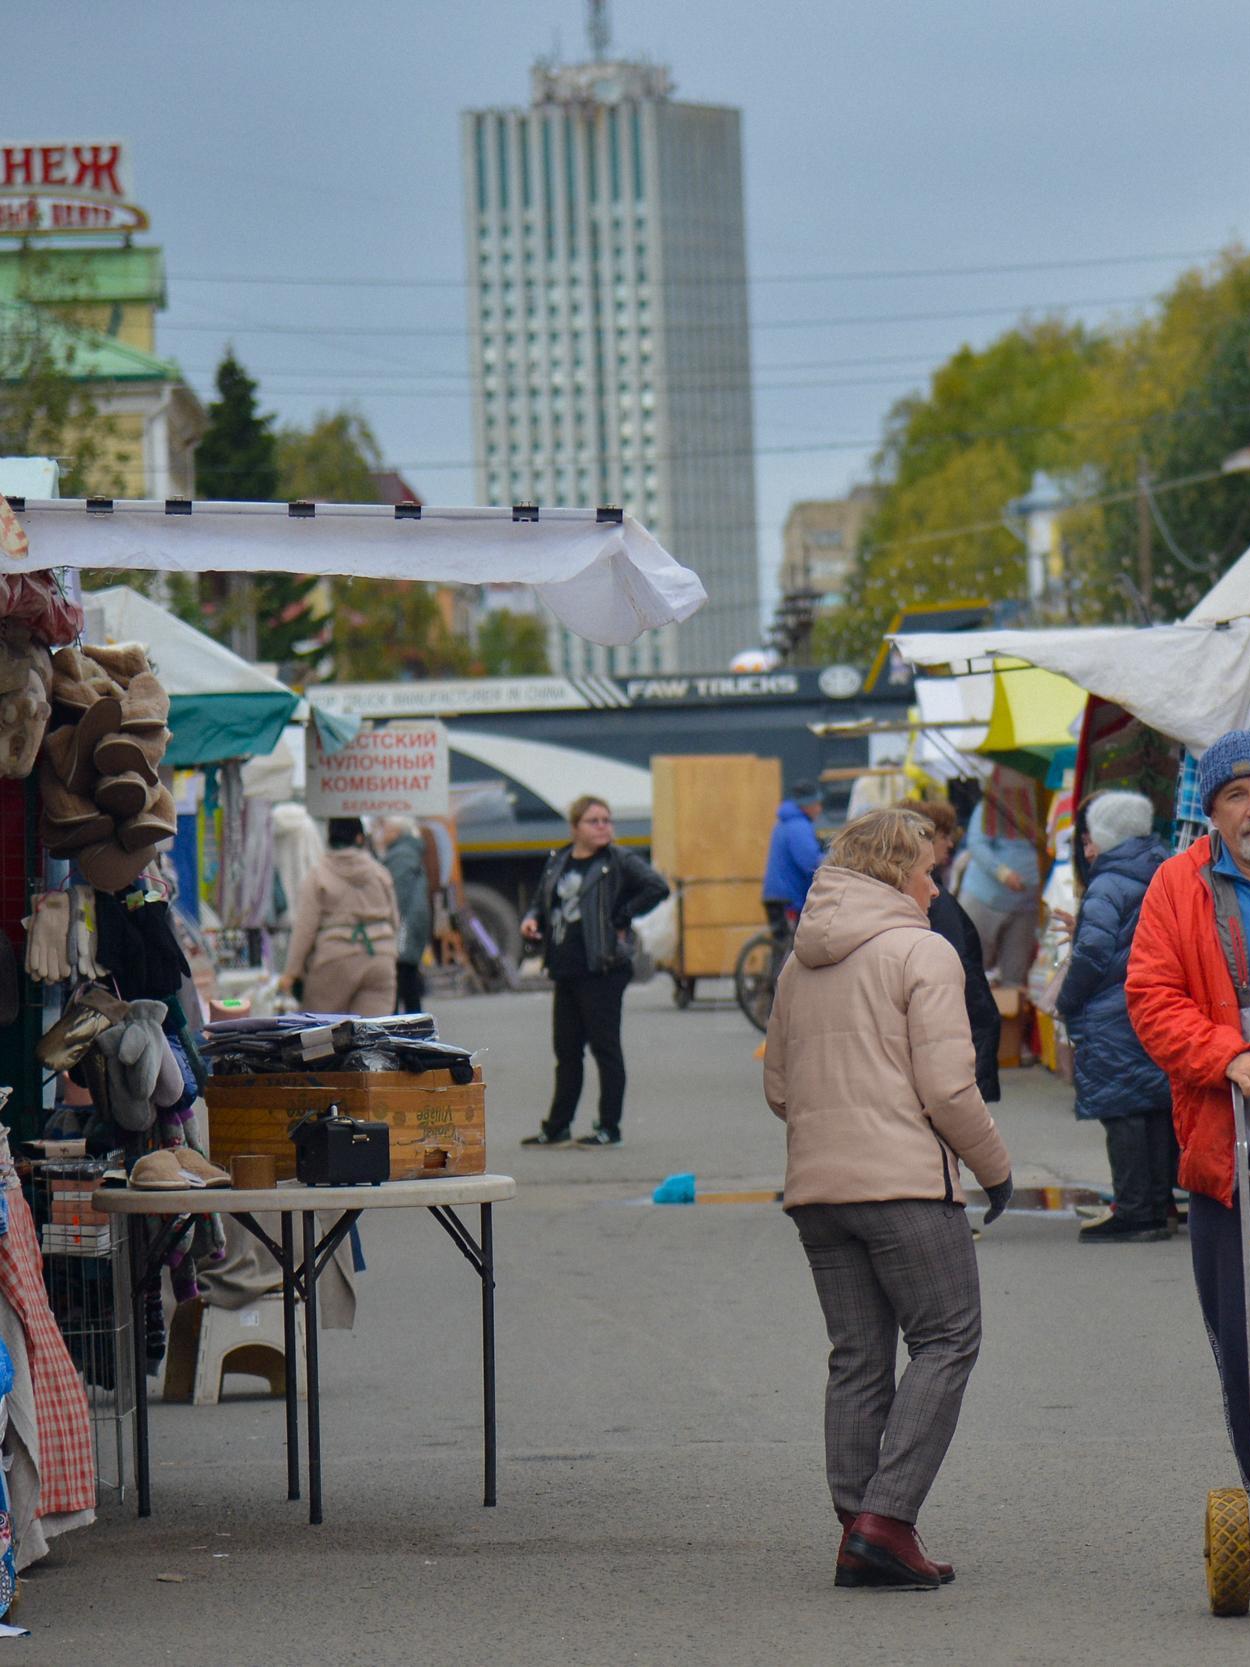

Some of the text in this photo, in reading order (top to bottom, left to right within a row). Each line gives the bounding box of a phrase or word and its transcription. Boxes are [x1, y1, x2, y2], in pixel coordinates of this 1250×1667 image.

[627, 675, 798, 700] FAW TRUCKS
[317, 731, 438, 752] СТСКИЙ
[319, 752, 436, 770] ЧУЛОЧНЫЙ
[321, 774, 433, 793] КОМБИНАТ
[341, 799, 412, 812] БЕЛАРУСЬ
